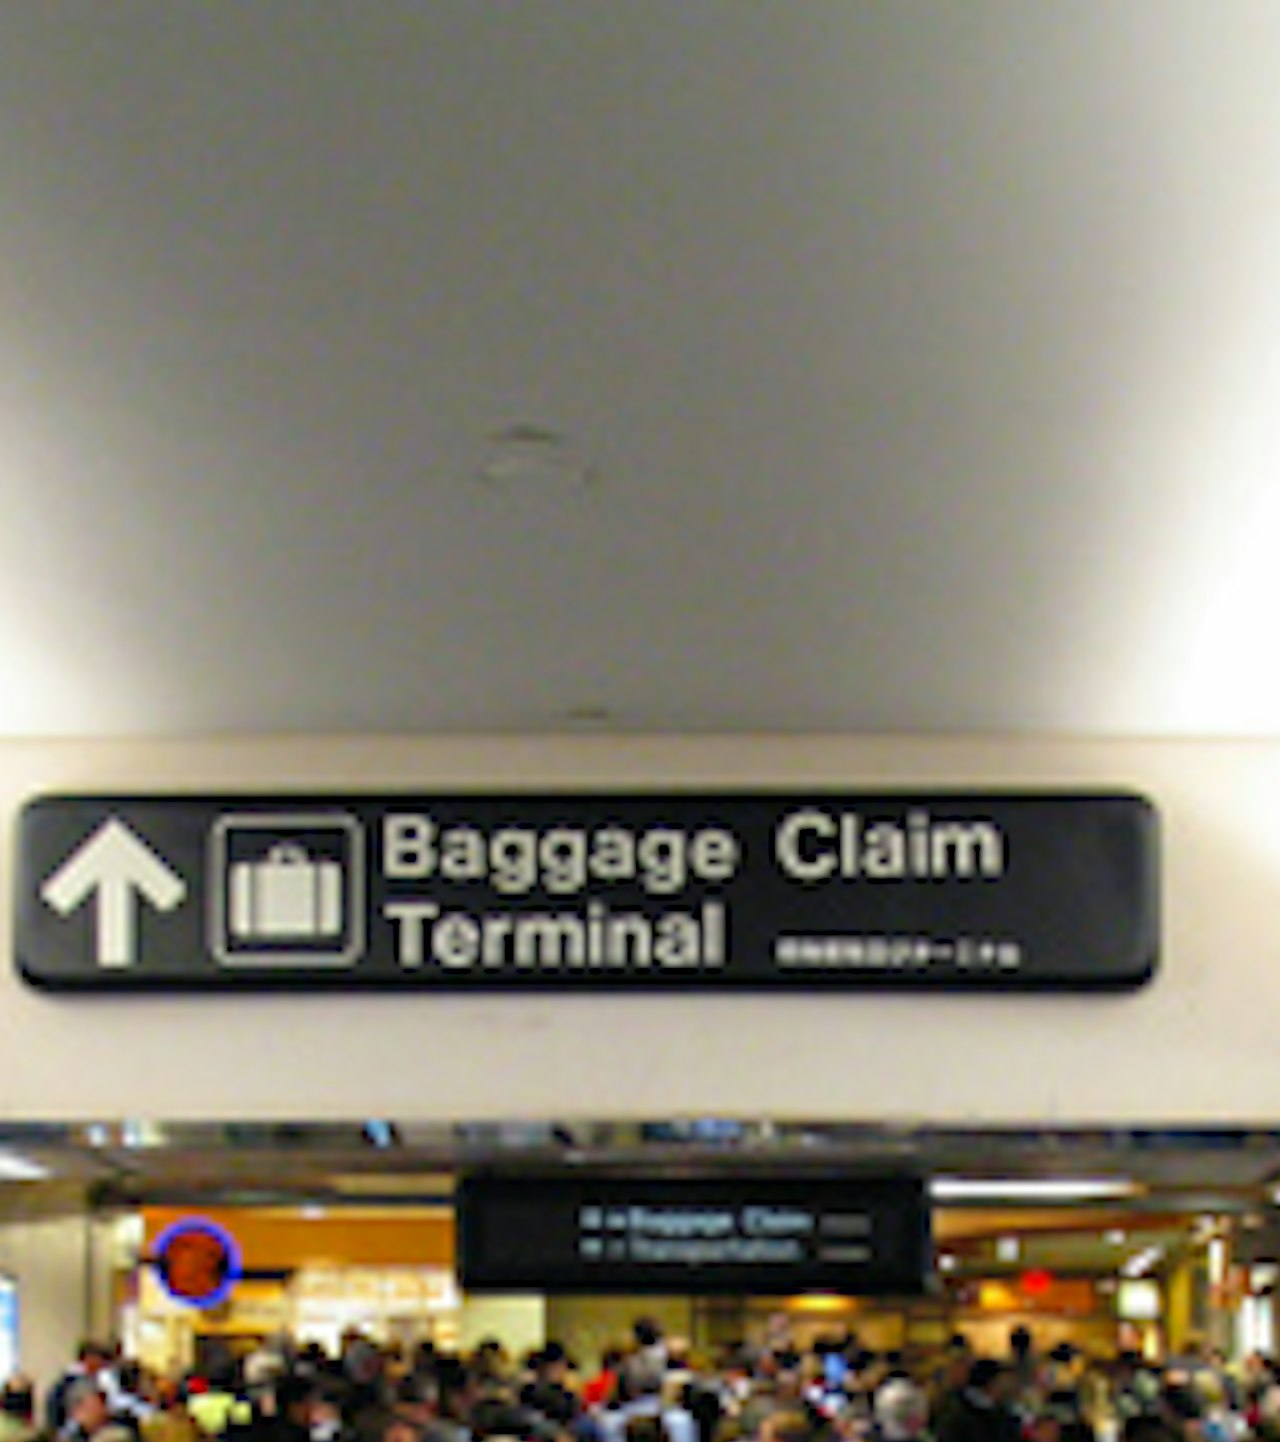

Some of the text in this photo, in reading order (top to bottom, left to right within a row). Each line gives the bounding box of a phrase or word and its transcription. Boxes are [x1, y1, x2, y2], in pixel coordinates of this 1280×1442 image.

[383, 811, 1003, 893] Baggage Claim
[384, 902, 724, 967] Terminal
